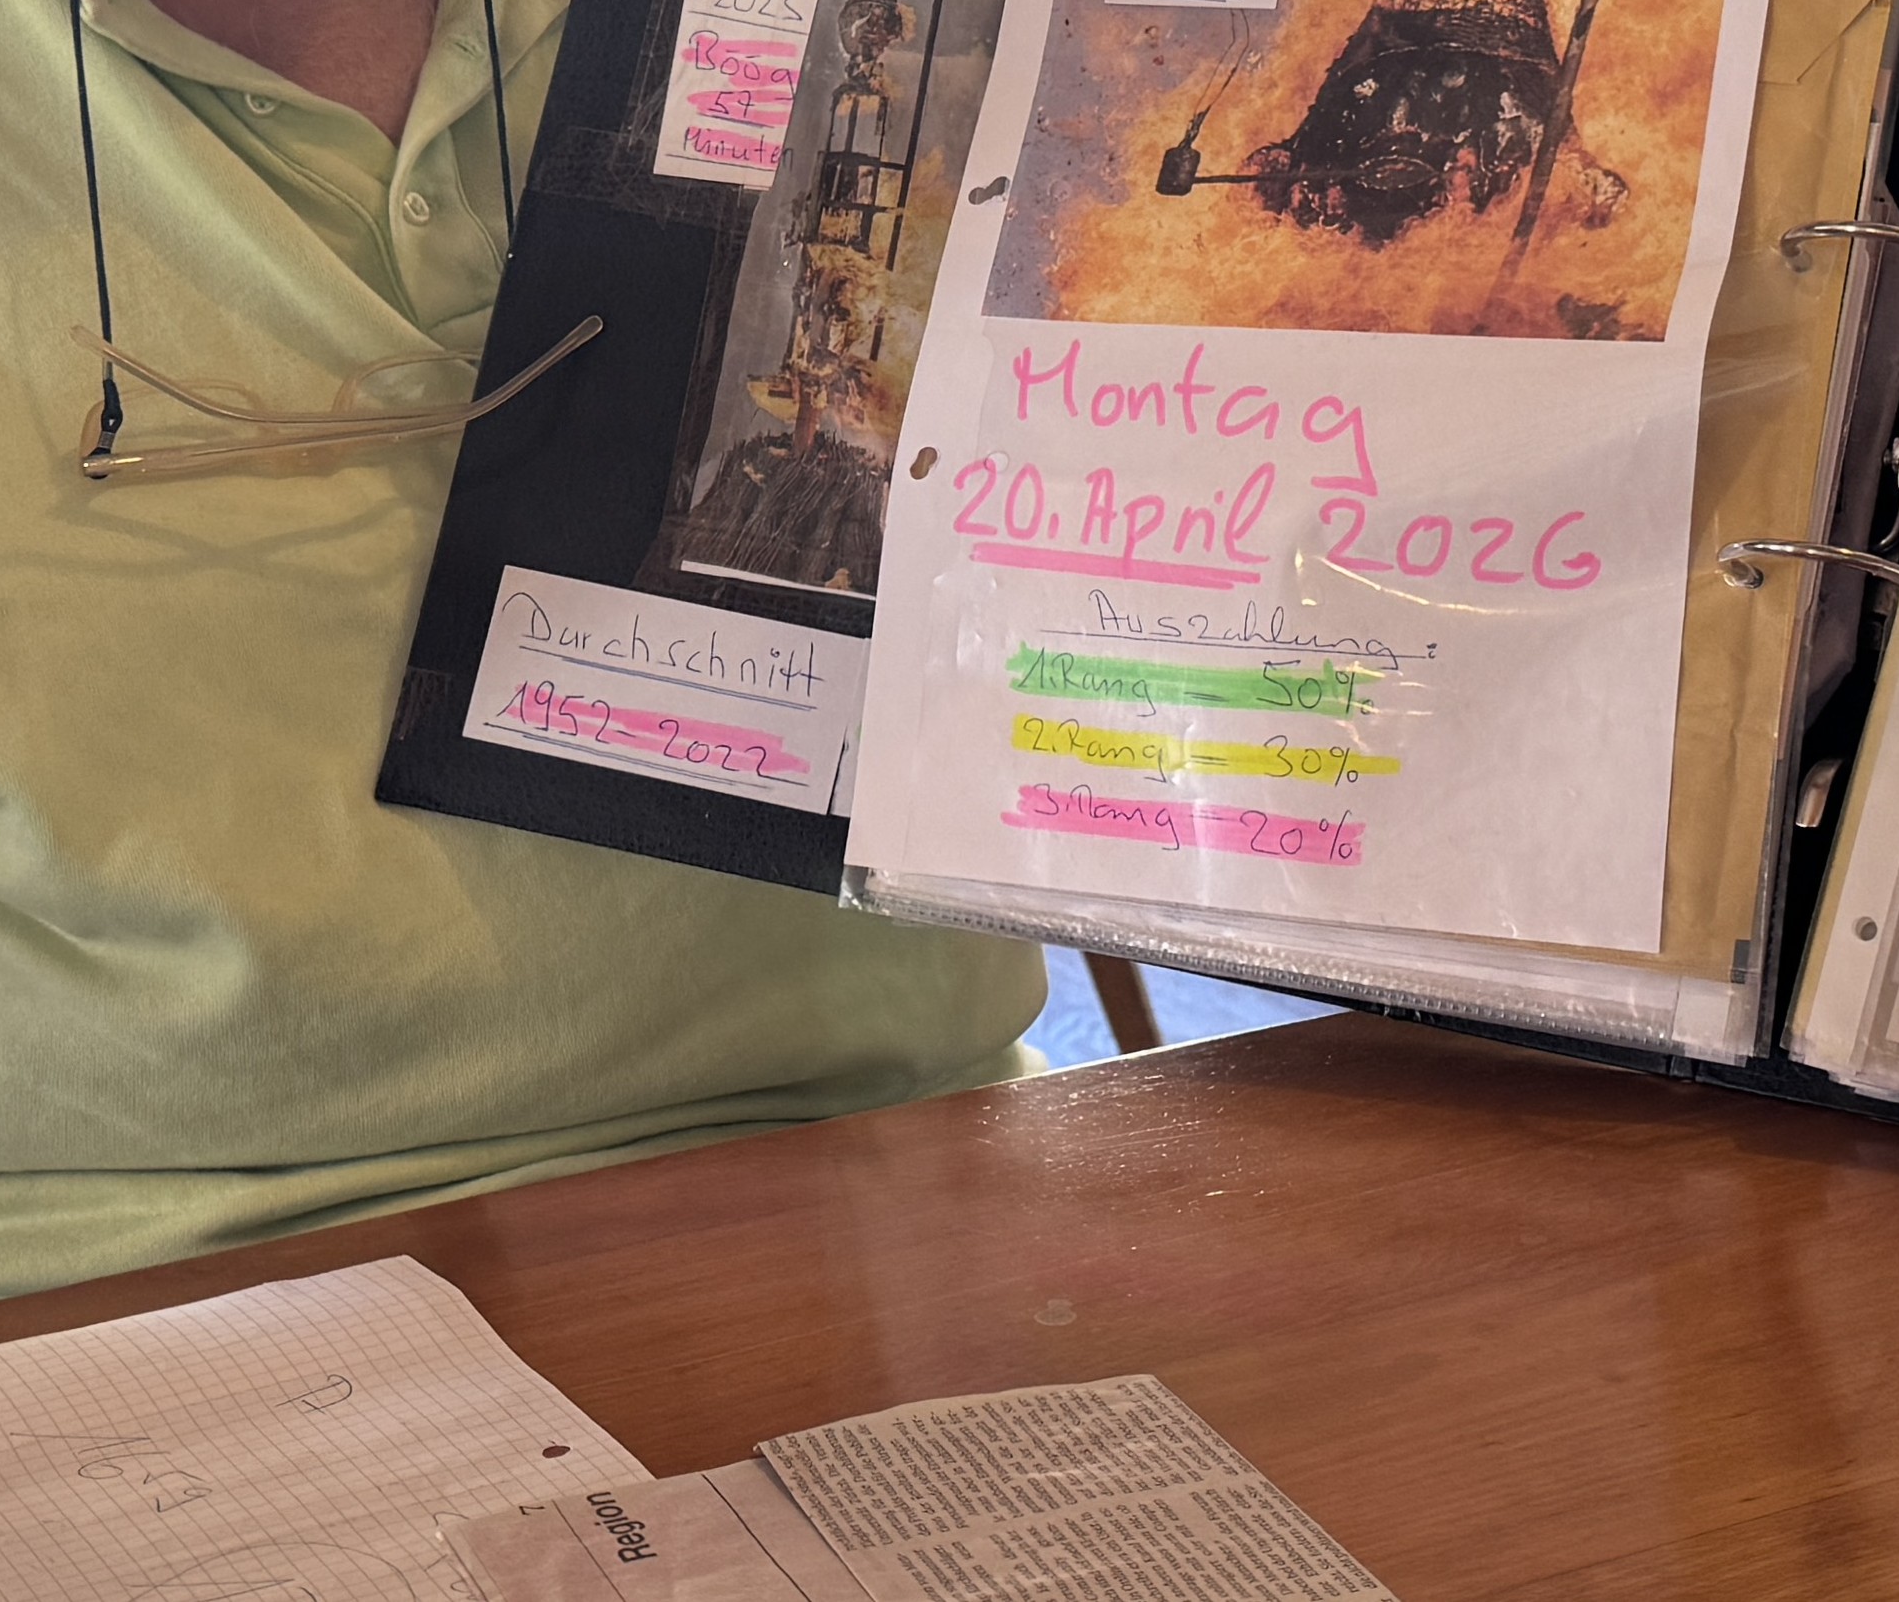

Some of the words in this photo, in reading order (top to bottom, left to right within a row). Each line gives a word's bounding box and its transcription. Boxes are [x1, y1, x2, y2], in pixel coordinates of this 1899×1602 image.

[708, 91, 754, 118] 57
[1013, 339, 1378, 497] Montag
[1318, 497, 1602, 589] 2026
[502, 592, 824, 696] Durchschnitt
[1258, 660, 1374, 715] 50%
[1265, 735, 1359, 786] 30%
[1240, 810, 1353, 860] 20%
[586, 1490, 658, 1563] Region
